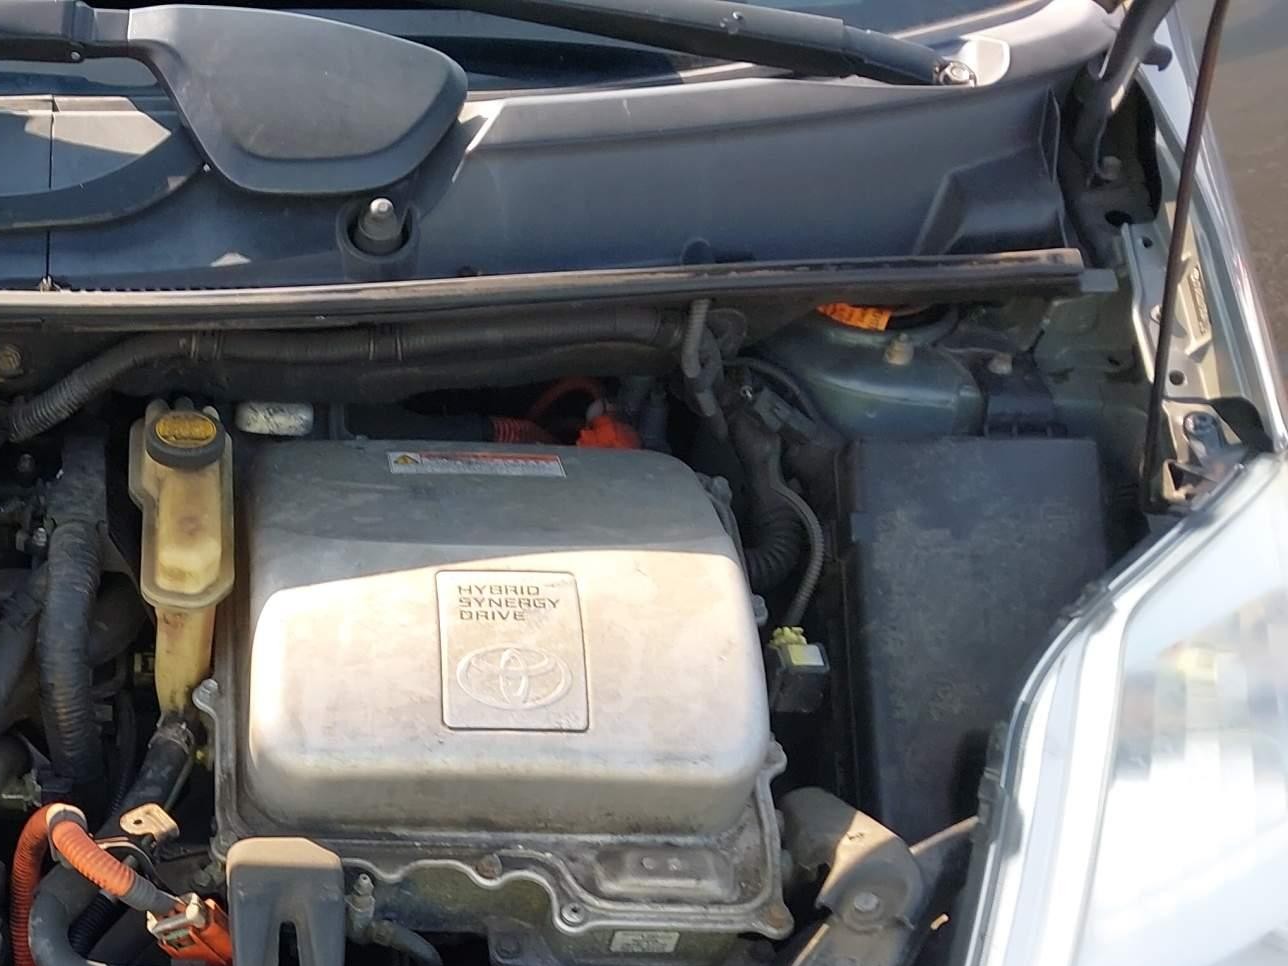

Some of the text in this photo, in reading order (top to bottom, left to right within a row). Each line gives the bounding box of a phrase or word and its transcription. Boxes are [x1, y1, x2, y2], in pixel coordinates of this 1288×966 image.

[457, 585, 540, 596] HYBRID
[458, 597, 560, 609] SYNERGY
[459, 610, 526, 621] DRIVE
